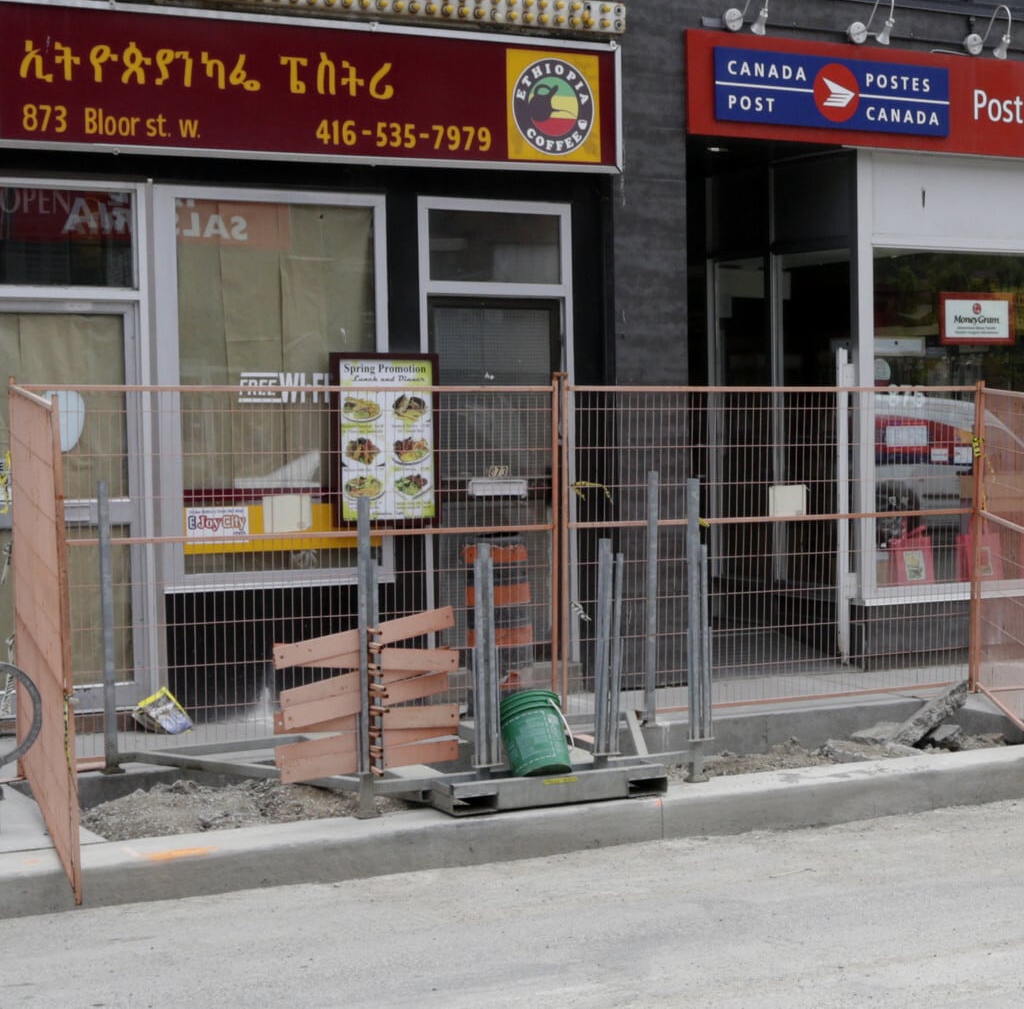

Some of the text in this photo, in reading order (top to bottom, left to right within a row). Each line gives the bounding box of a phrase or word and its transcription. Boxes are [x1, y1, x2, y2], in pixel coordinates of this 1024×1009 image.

[727, 60, 807, 82] CANADA
[516, 63, 589, 105] ETHIOPIA
[866, 73, 931, 92] POSTES
[728, 95, 775, 112] POST
[973, 89, 1023, 124] Post
[22, 103, 68, 132] 873
[84, 107, 140, 137] Bloor
[146, 114, 172, 138] st.
[866, 107, 939, 126] CANADA
[315, 119, 492, 152] 416-535-7979
[526, 128, 583, 151] COFFEE
[953, 315, 1000, 325] MoneyGram
[344, 363, 426, 374] Spring Promotion
[240, 379, 277, 396] FREE
